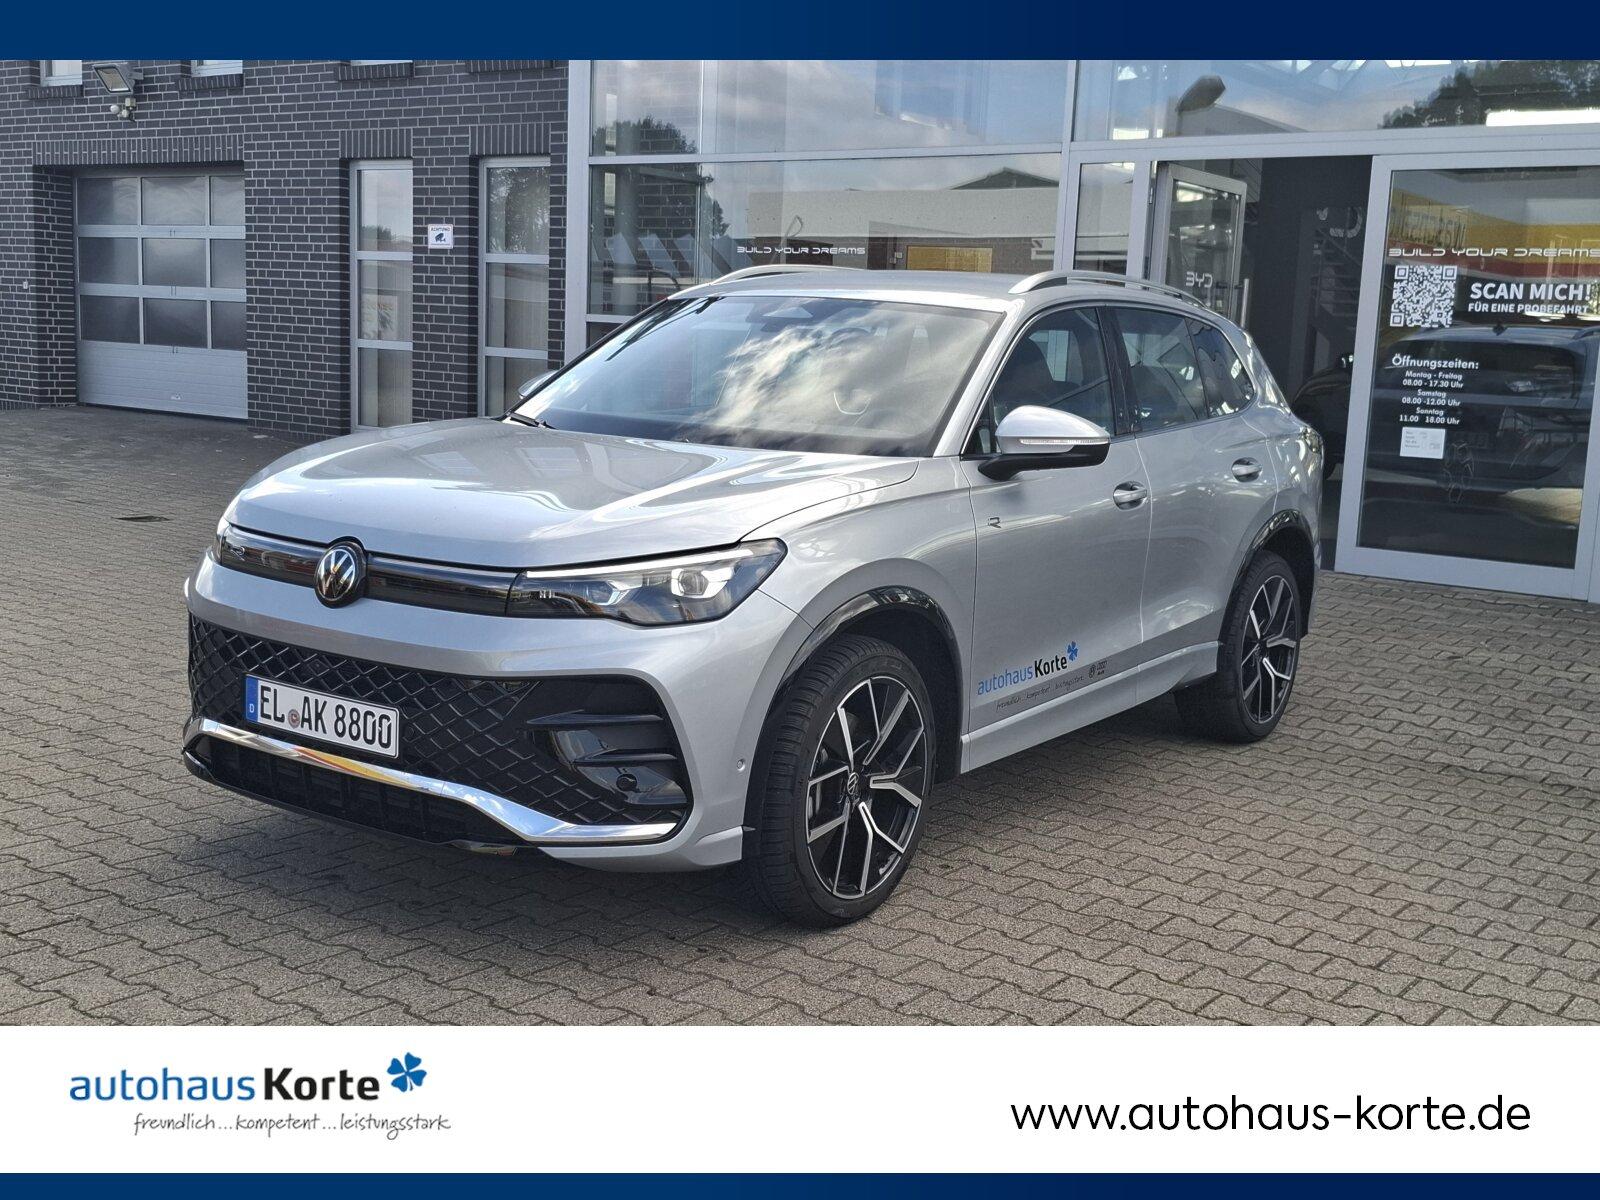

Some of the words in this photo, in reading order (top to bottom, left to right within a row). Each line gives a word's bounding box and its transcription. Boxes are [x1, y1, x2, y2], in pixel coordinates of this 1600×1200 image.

[1388, 248, 1446, 256] BUILD
[1451, 248, 1508, 257] YOUR
[1514, 248, 1600, 257] DREAMS
[1469, 283, 1524, 300] SCAN
[1530, 284, 1592, 301] MICH!
[1468, 302, 1489, 312] FÜR
[1491, 303, 1515, 313] EINE
[1517, 304, 1588, 314] PROBEFAHRT
[1391, 353, 1479, 370] Öffnungszeiten:
[1405, 370, 1432, 379] Montag
[1438, 372, 1463, 381] Freitag
[1417, 389, 1447, 398] Samstag
[1416, 407, 1444, 416] Sonntag
[1399, 414, 1419, 422] 11.00
[1446, 417, 1460, 425] Uhr
[977, 665, 1034, 695] autohaus
[1034, 655, 1068, 678] Korte
[249, 703, 255, 713] D
[260, 685, 285, 723] EL
[300, 696, 328, 735] AK
[333, 704, 392, 749] 8800
